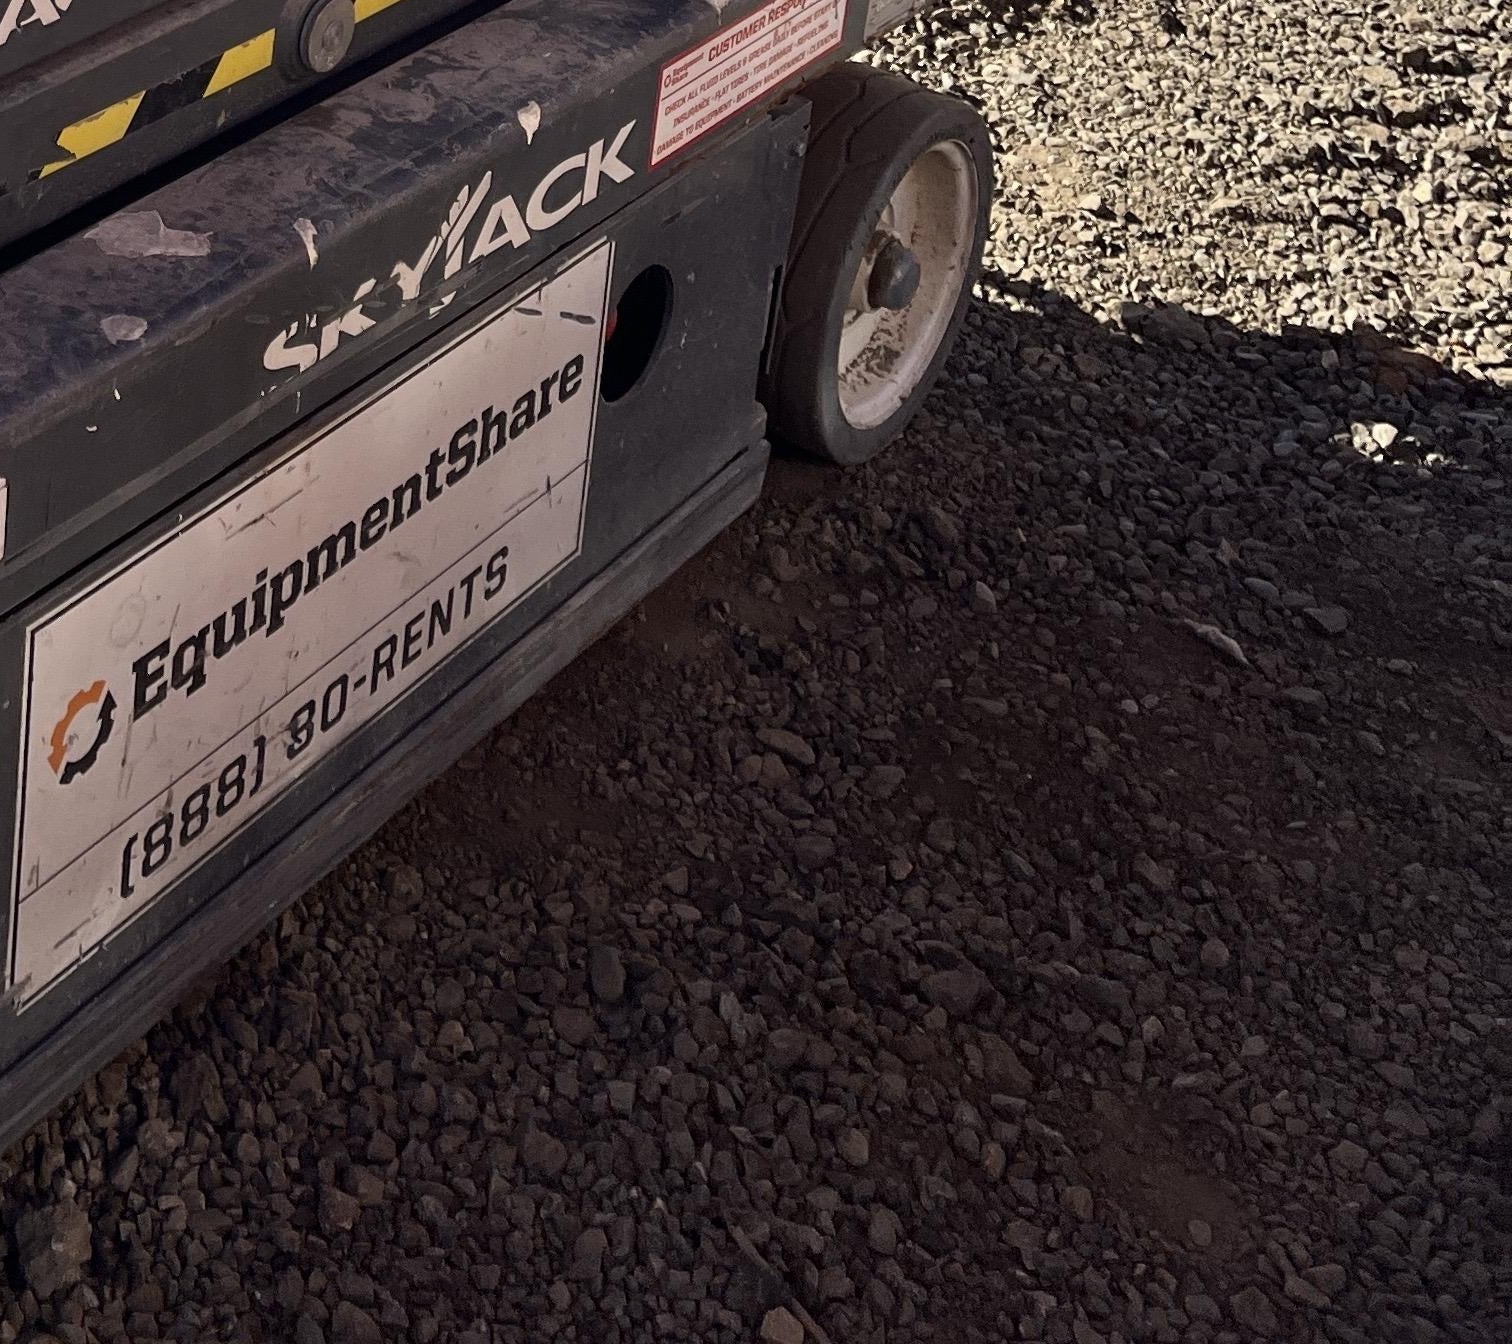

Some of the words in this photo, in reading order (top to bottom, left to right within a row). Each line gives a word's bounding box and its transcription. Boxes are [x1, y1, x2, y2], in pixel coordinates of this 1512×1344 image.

[686, 86, 699, 102] ALL
[707, 13, 767, 63] CUSTOMER
[131, 353, 584, 723] EquipmentShare
[121, 737, 265, 898] (888)
[287, 545, 509, 760] 80-RENTS
